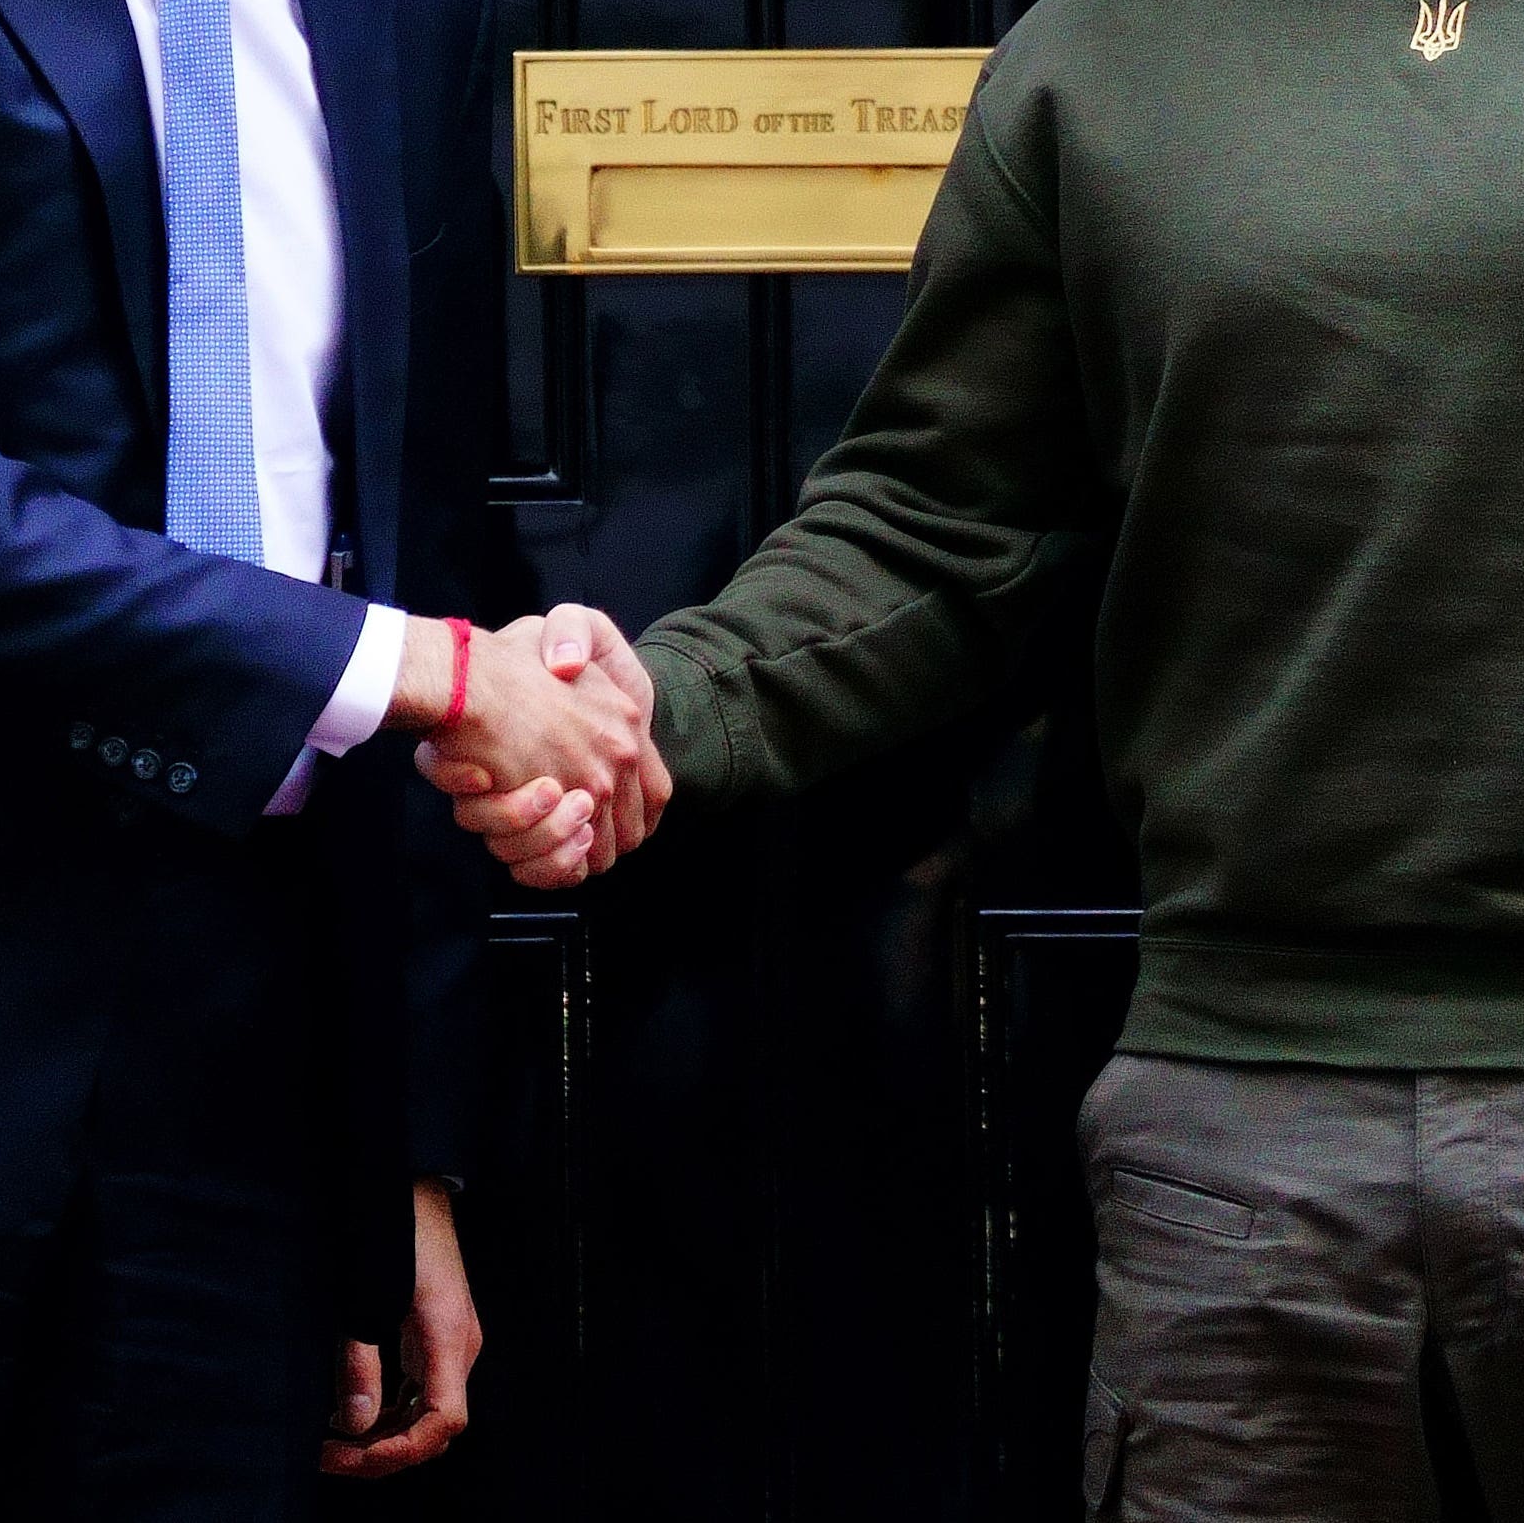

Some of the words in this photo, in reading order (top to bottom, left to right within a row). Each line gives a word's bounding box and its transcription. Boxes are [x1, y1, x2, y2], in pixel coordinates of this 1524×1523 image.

[534, 99, 631, 135] FIRST
[640, 99, 739, 135] LORD
[753, 112, 784, 133] OF
[787, 112, 835, 133] THE
